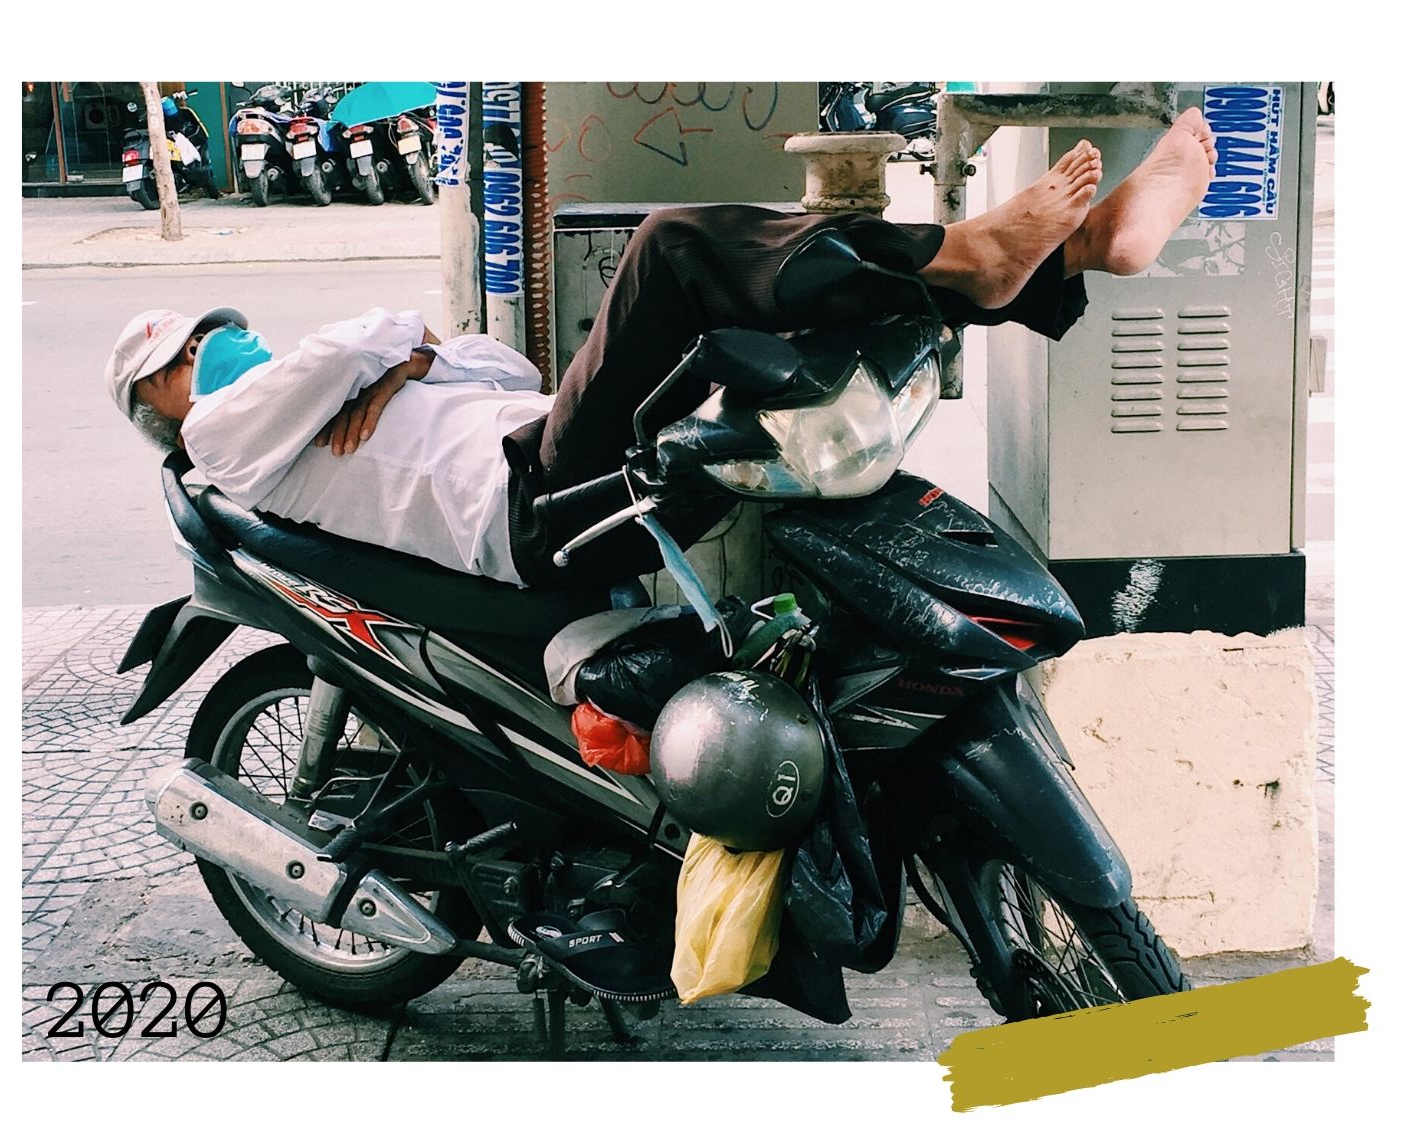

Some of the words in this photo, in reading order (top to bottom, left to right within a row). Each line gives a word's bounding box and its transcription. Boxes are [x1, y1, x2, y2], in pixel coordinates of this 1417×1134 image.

[1205, 87, 1268, 132] 0908
[1271, 89, 1283, 127] HÚT
[1214, 136, 1265, 177] 444
[1199, 181, 1263, 218] 606
[568, 934, 603, 948] SPORT
